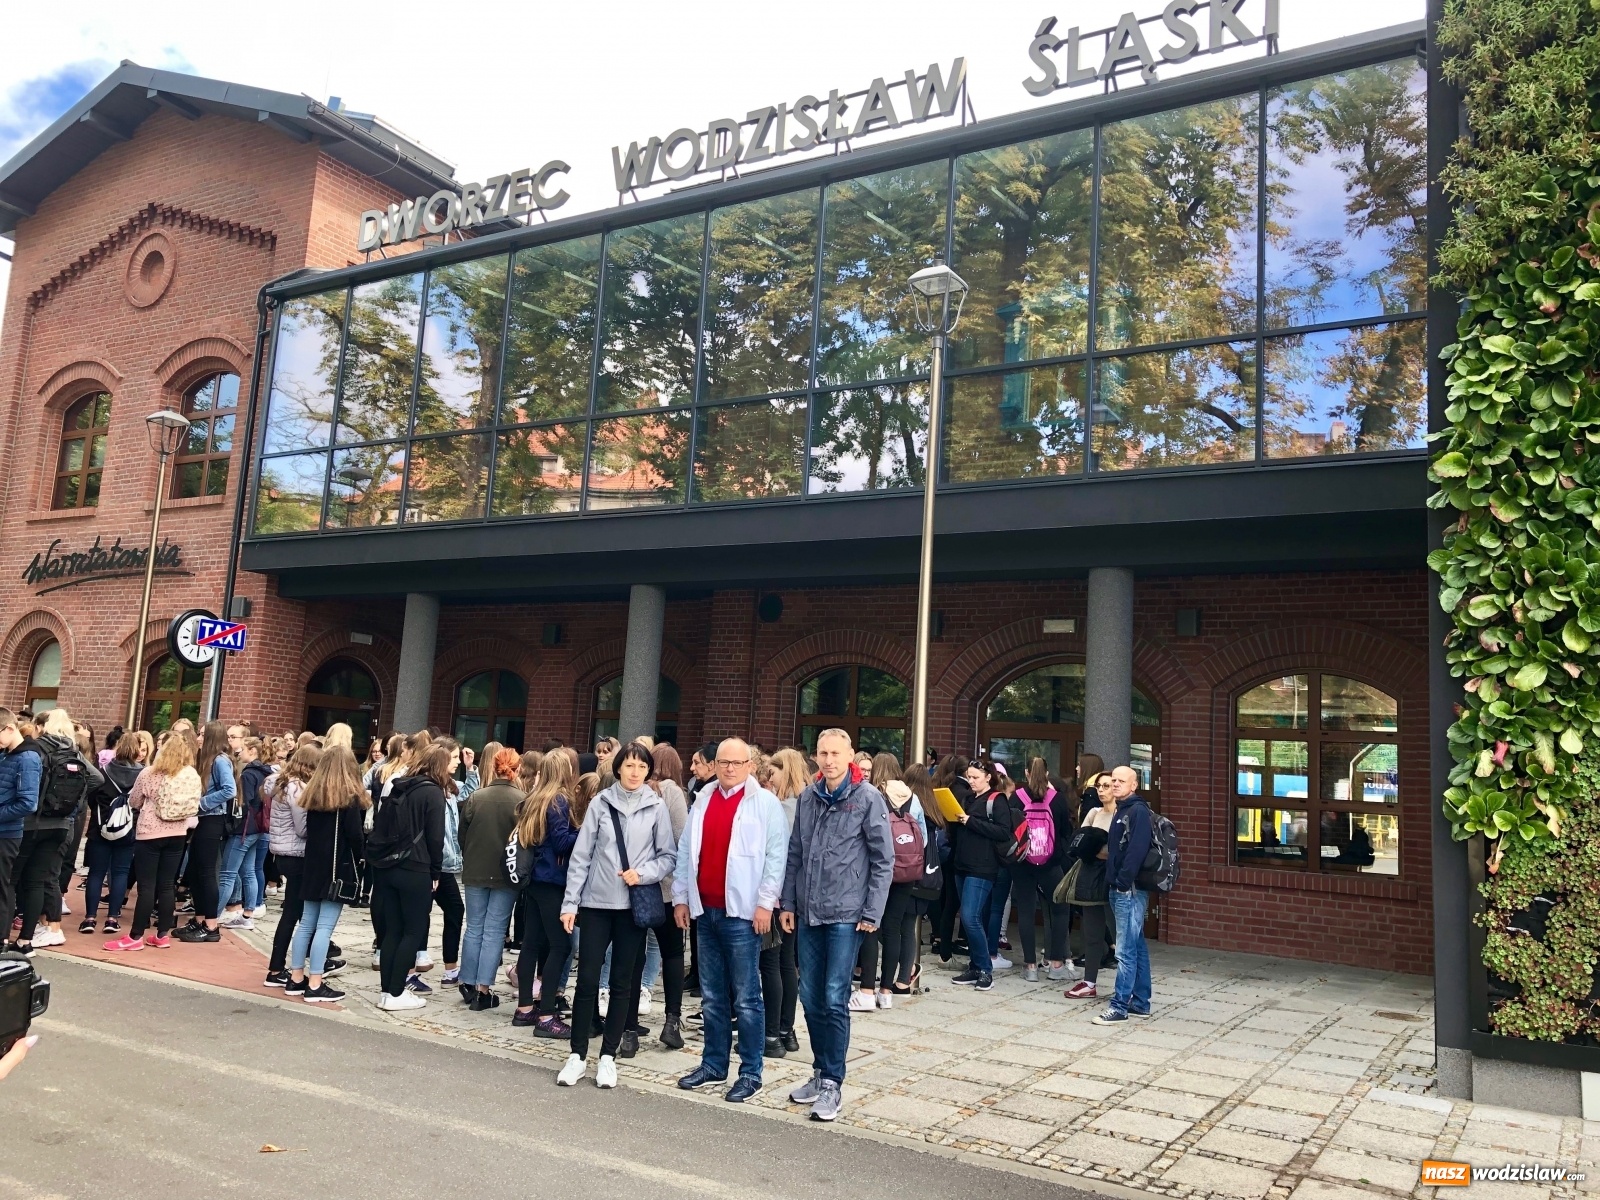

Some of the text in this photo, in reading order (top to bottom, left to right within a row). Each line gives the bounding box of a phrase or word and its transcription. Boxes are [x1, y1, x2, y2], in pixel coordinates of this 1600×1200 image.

[358, 0, 1279, 252] DWORZEC WODZISŁAW ŚLĄSKI
[201, 622, 243, 647] TAXI
